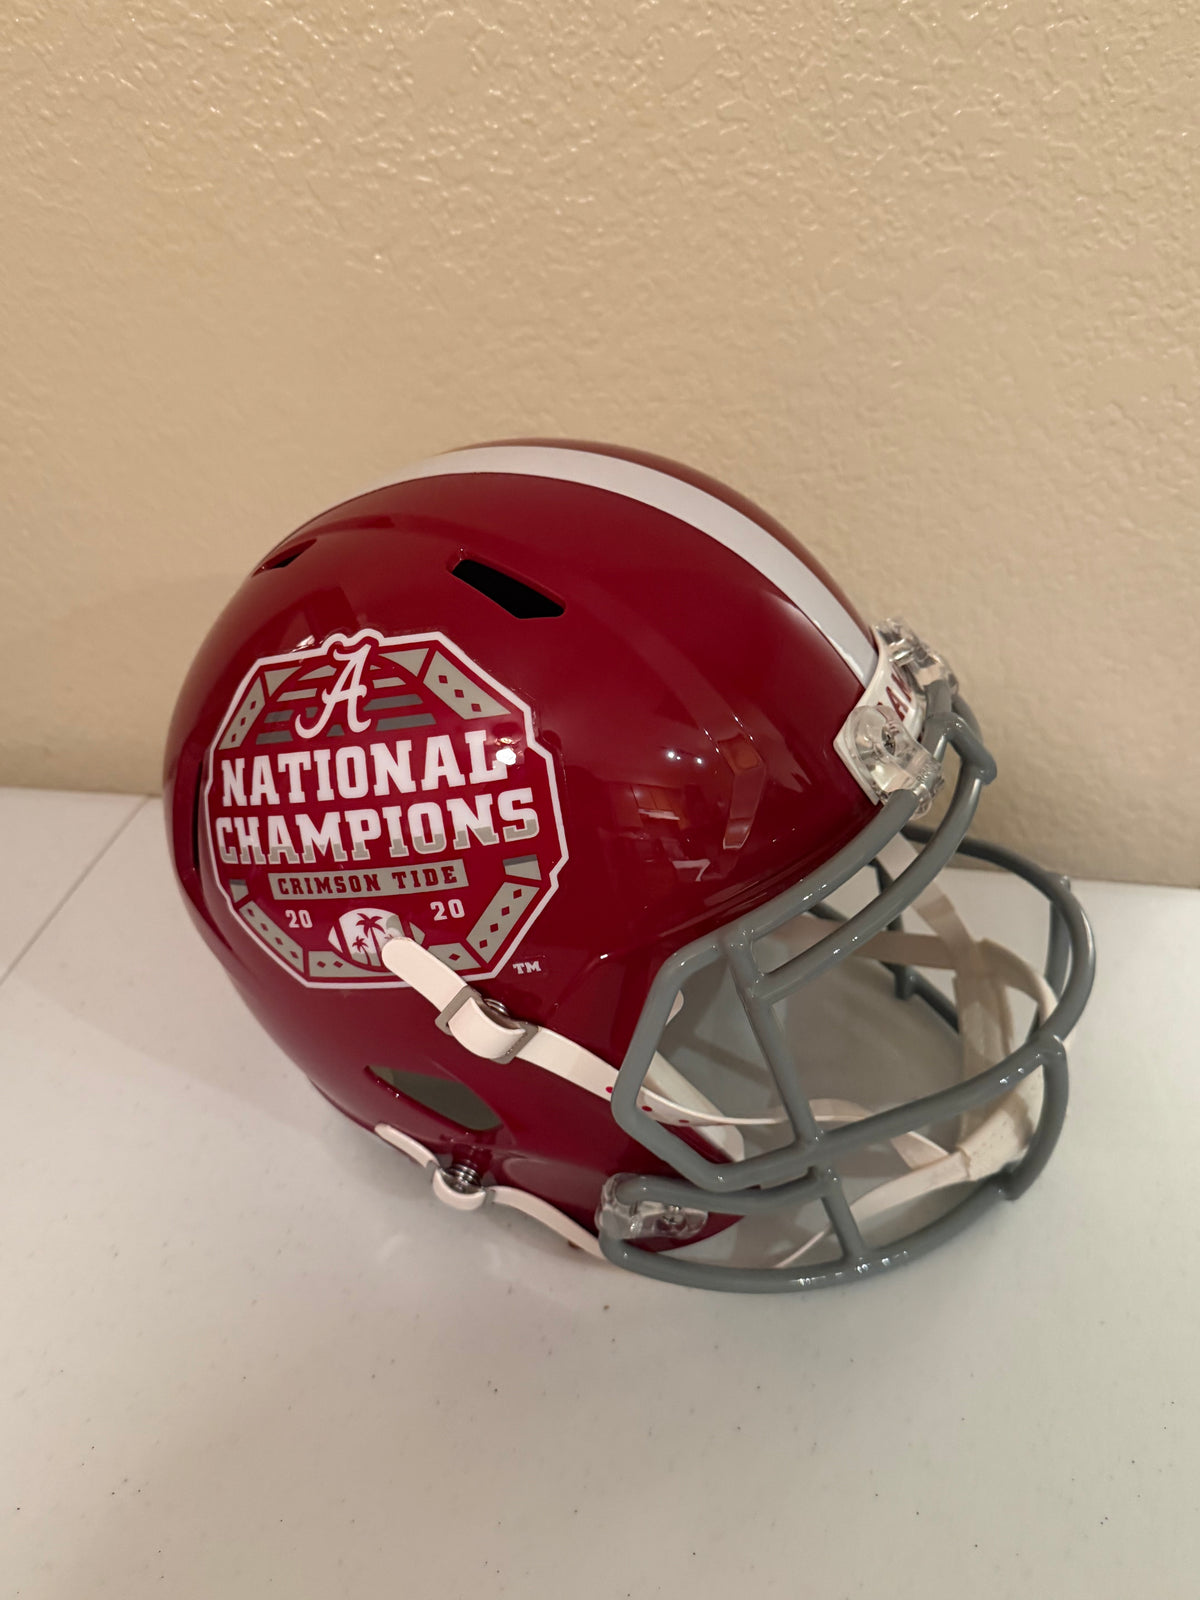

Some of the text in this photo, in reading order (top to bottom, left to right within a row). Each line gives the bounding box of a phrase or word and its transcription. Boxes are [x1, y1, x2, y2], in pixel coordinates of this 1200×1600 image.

[294, 644, 372, 739] A
[221, 729, 508, 807] NATIONAL
[215, 787, 540, 865] CHAMPIONS
[278, 866, 457, 895] CRIMSON TIDE
[285, 898, 465, 929] 20 20
[513, 962, 541, 974] TM
